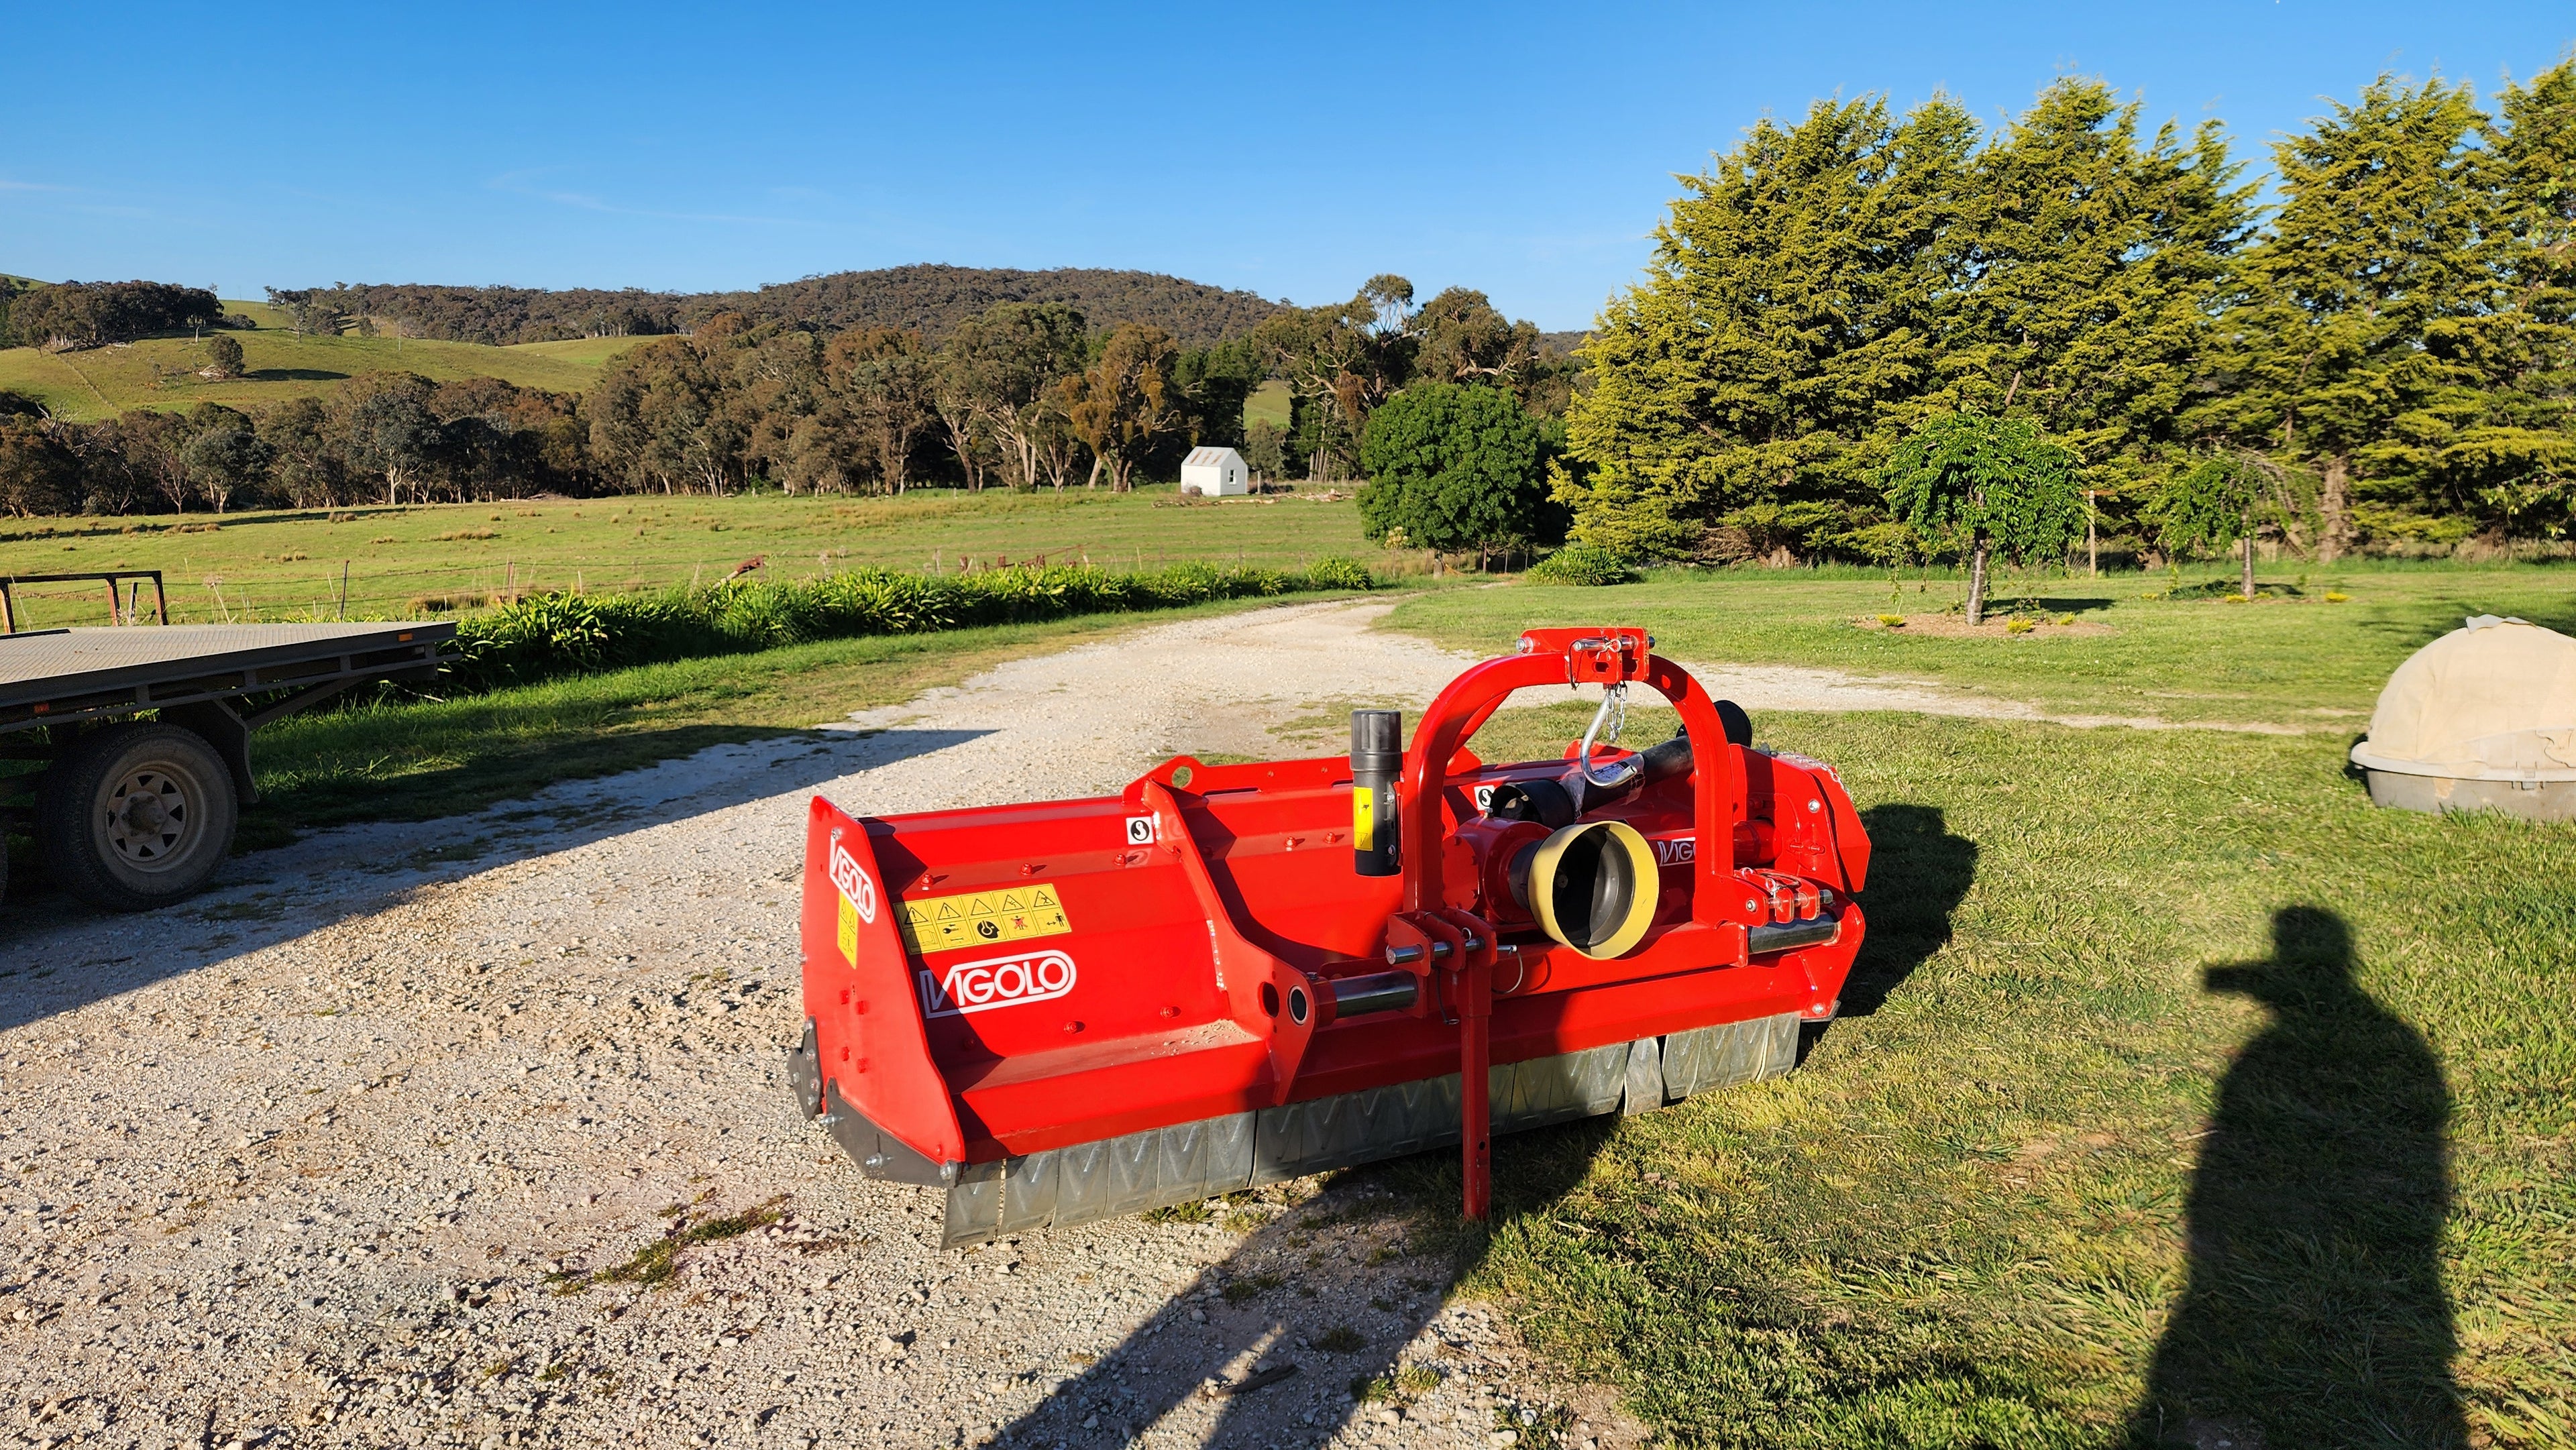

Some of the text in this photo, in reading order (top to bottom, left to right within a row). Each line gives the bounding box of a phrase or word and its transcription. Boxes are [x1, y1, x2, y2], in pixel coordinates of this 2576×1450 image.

[830, 834, 875, 923] VIGOLO
[1657, 837, 1695, 867] VIG
[918, 950, 1076, 1018] VIGOLO
